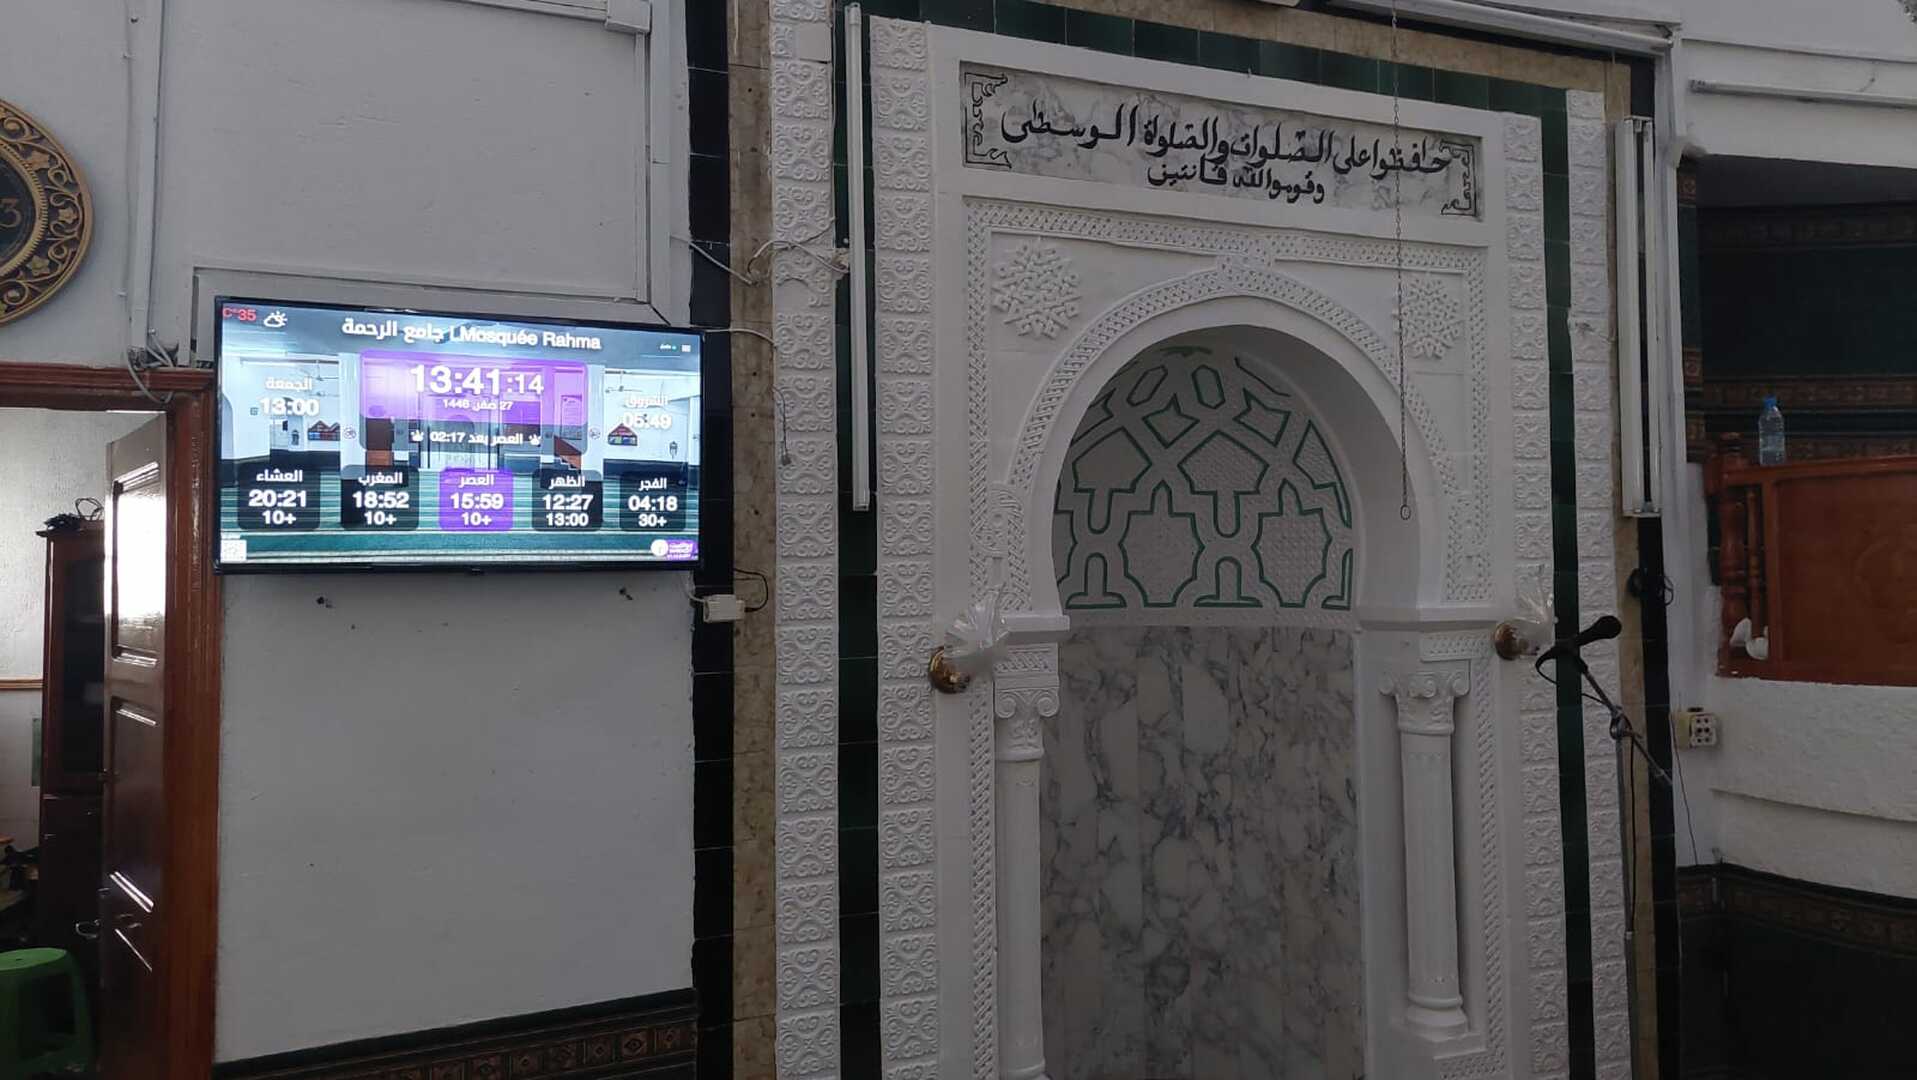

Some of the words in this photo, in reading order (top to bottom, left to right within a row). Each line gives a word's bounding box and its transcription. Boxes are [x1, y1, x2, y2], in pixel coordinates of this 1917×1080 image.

[1001, 97, 1140, 149] الوسطى
[1332, 134, 1371, 175] على
[1147, 153, 1229, 187] قانتين
[341, 317, 398, 341] الرحمة
[402, 322, 444, 344] جامع
[542, 331, 602, 351] Rahma
[264, 375, 313, 391] الجمعة
[259, 397, 320, 416] 13:00
[499, 400, 513, 411] 27
[429, 430, 465, 444] 02:17
[467, 431, 489, 445] بعد
[490, 433, 523, 446] العصر
[255, 468, 303, 483] العشاء
[357, 471, 403, 487] المغرب
[457, 473, 494, 489] العصر
[548, 474, 586, 490] الظهر
[638, 477, 668, 491] الفجر
[247, 489, 307, 508] 20:21
[351, 491, 410, 510] 18:52
[449, 492, 505, 510] 15:59
[541, 493, 595, 511] 12:27
[627, 494, 678, 512] 04:18
[261, 509, 297, 525] 10+
[363, 511, 397, 526] 10+
[460, 512, 492, 526] 10+
[545, 512, 590, 527] 13:00
[637, 513, 668, 528] 30+
